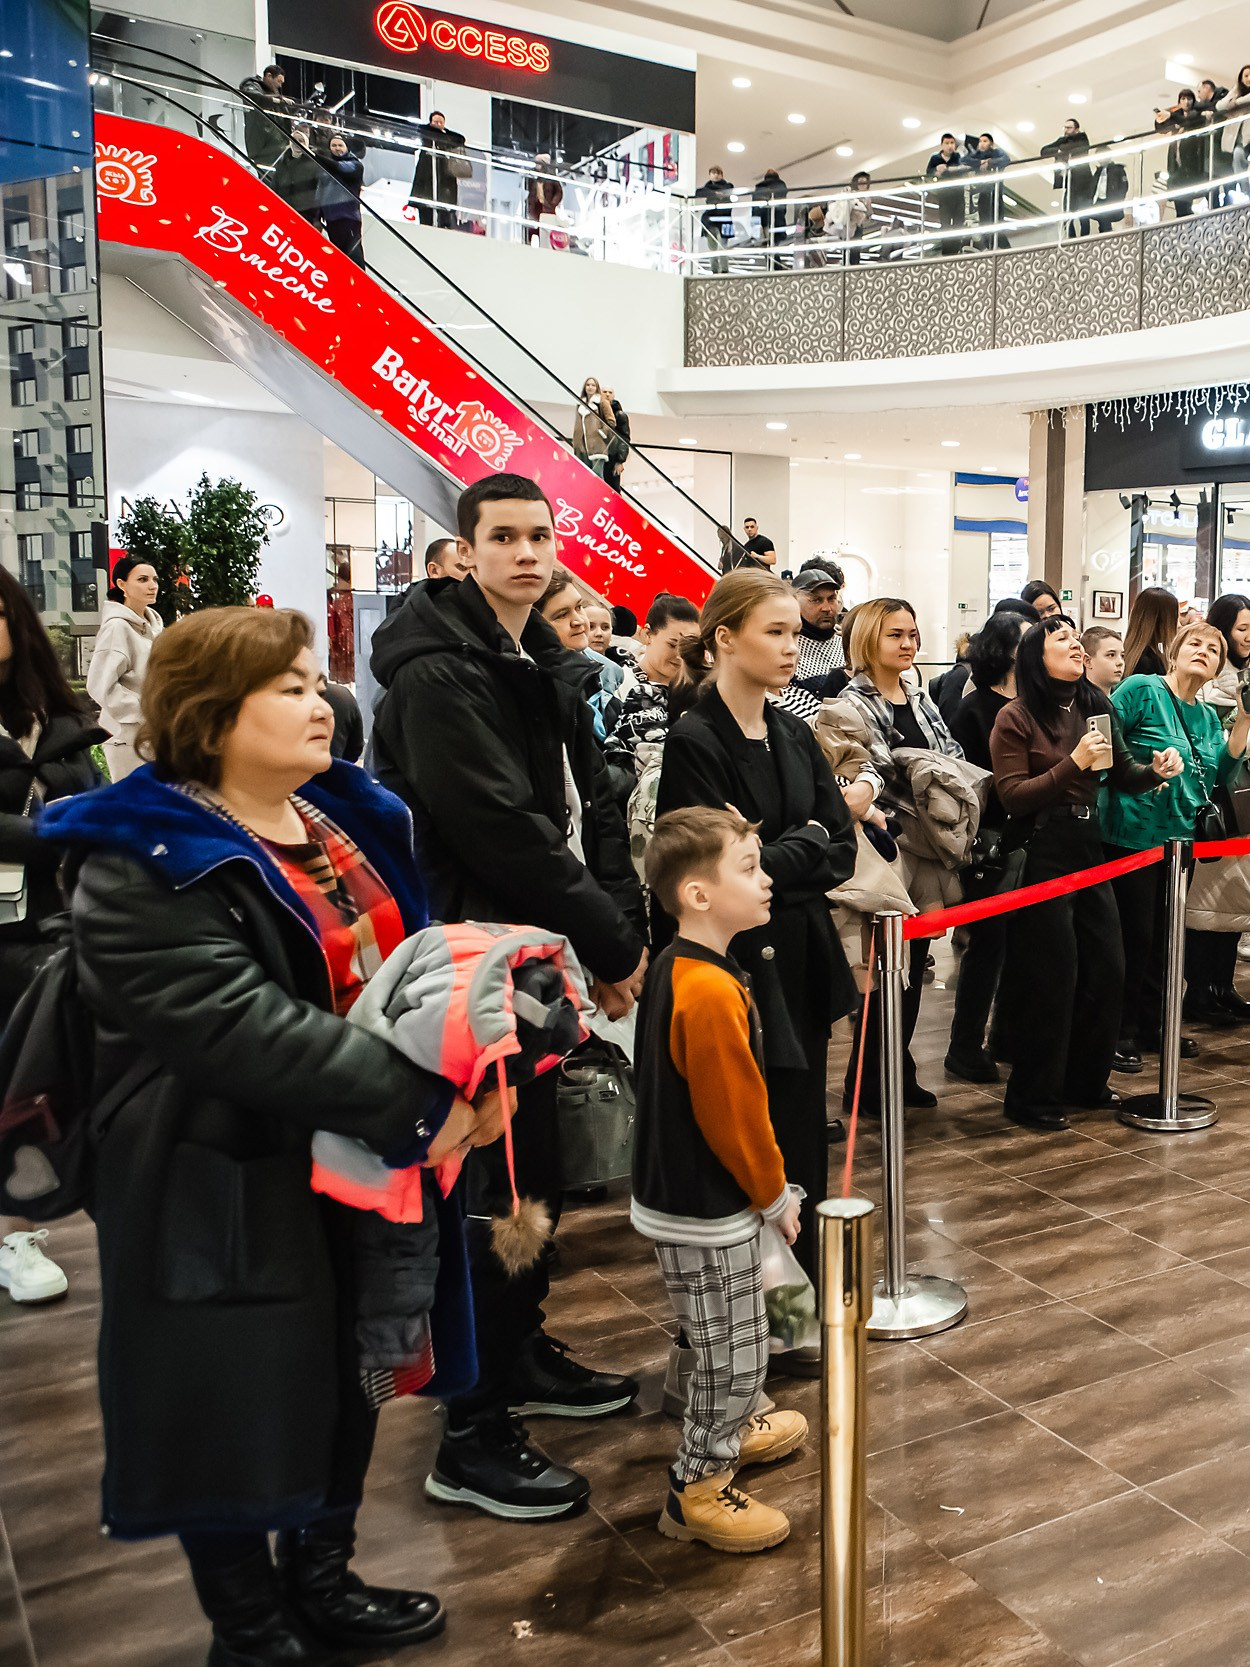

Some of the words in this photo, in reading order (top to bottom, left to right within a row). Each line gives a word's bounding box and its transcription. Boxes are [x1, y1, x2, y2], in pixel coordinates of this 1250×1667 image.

[193, 205, 336, 314] Вместе
[261, 223, 329, 288] Бірге
[371, 345, 456, 426] Batyr
[426, 420, 468, 457] mall
[554, 498, 647, 577] Вместе
[592, 507, 642, 557] Бірге
